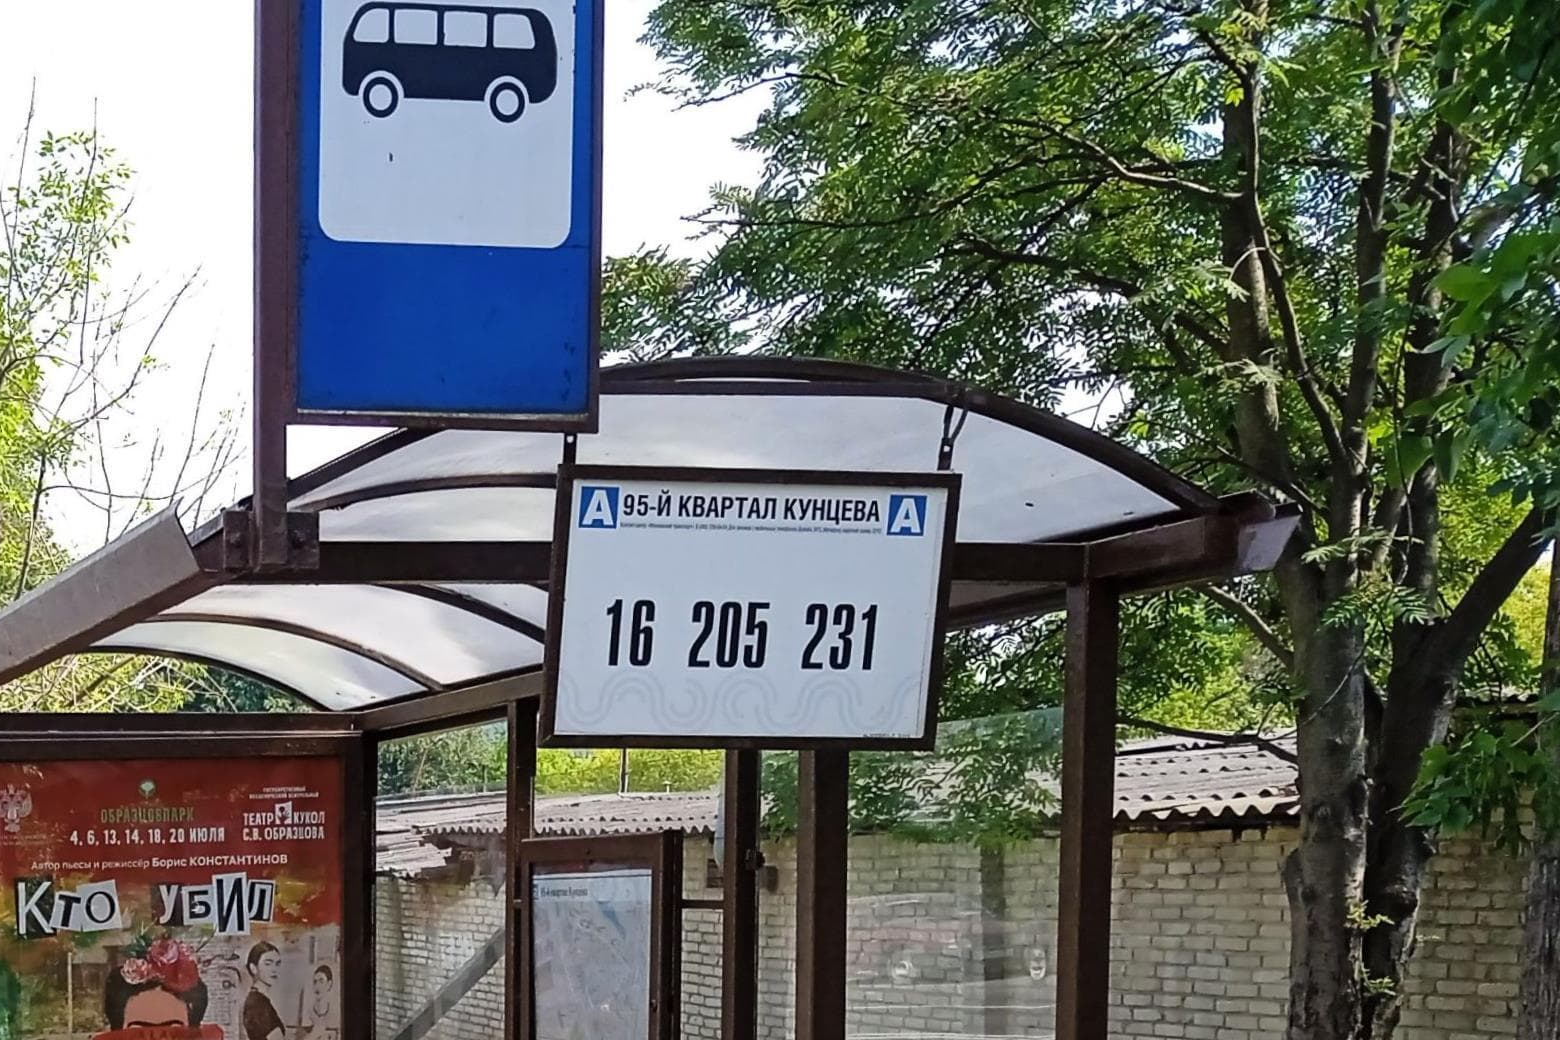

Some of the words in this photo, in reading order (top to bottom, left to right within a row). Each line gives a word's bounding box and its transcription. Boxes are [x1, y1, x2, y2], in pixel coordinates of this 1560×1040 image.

[623, 488, 672, 518] 95-Й
[677, 495, 778, 521] КВАРТАЛ
[783, 498, 881, 526] КУНЦЕВА
[605, 598, 656, 668] 16
[687, 600, 771, 670] 205
[800, 602, 878, 671] 231
[243, 812, 274, 826] ТЕАТР
[293, 811, 326, 825] КУКОЛ
[169, 827, 185, 844] 20
[189, 826, 225, 843] ИЮЛЯ
[264, 826, 326, 841] ОБРАЗЦОВА
[31, 860, 60, 870] Автор
[62, 861, 92, 870] пьесы
[151, 857, 188, 868] Борис
[189, 853, 289, 867] КОНСТАНТИНОВ
